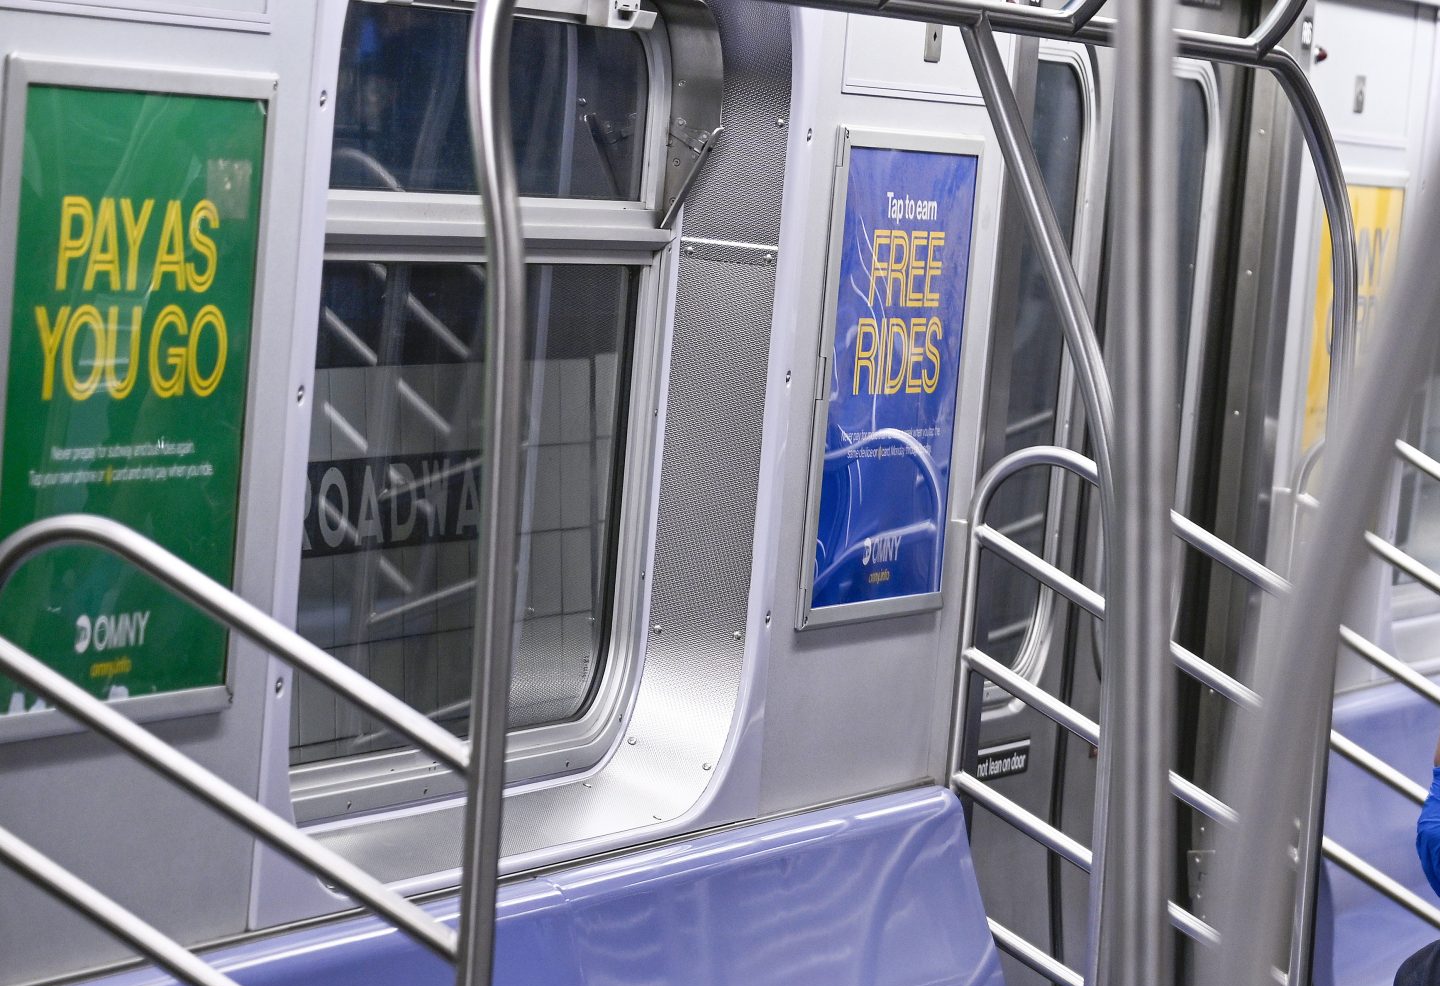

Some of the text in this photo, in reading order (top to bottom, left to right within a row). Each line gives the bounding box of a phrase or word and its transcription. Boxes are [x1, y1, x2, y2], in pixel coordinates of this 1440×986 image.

[886, 191, 938, 224] Tap to earn
[55, 195, 220, 293] PAY AS
[868, 229, 945, 307] FREE
[34, 303, 228, 401] YOU GO
[853, 316, 943, 395] RIDES
[872, 535, 902, 564] OMNY
[92, 610, 151, 651] OMNY
[977, 752, 1026, 778] not lean on door
